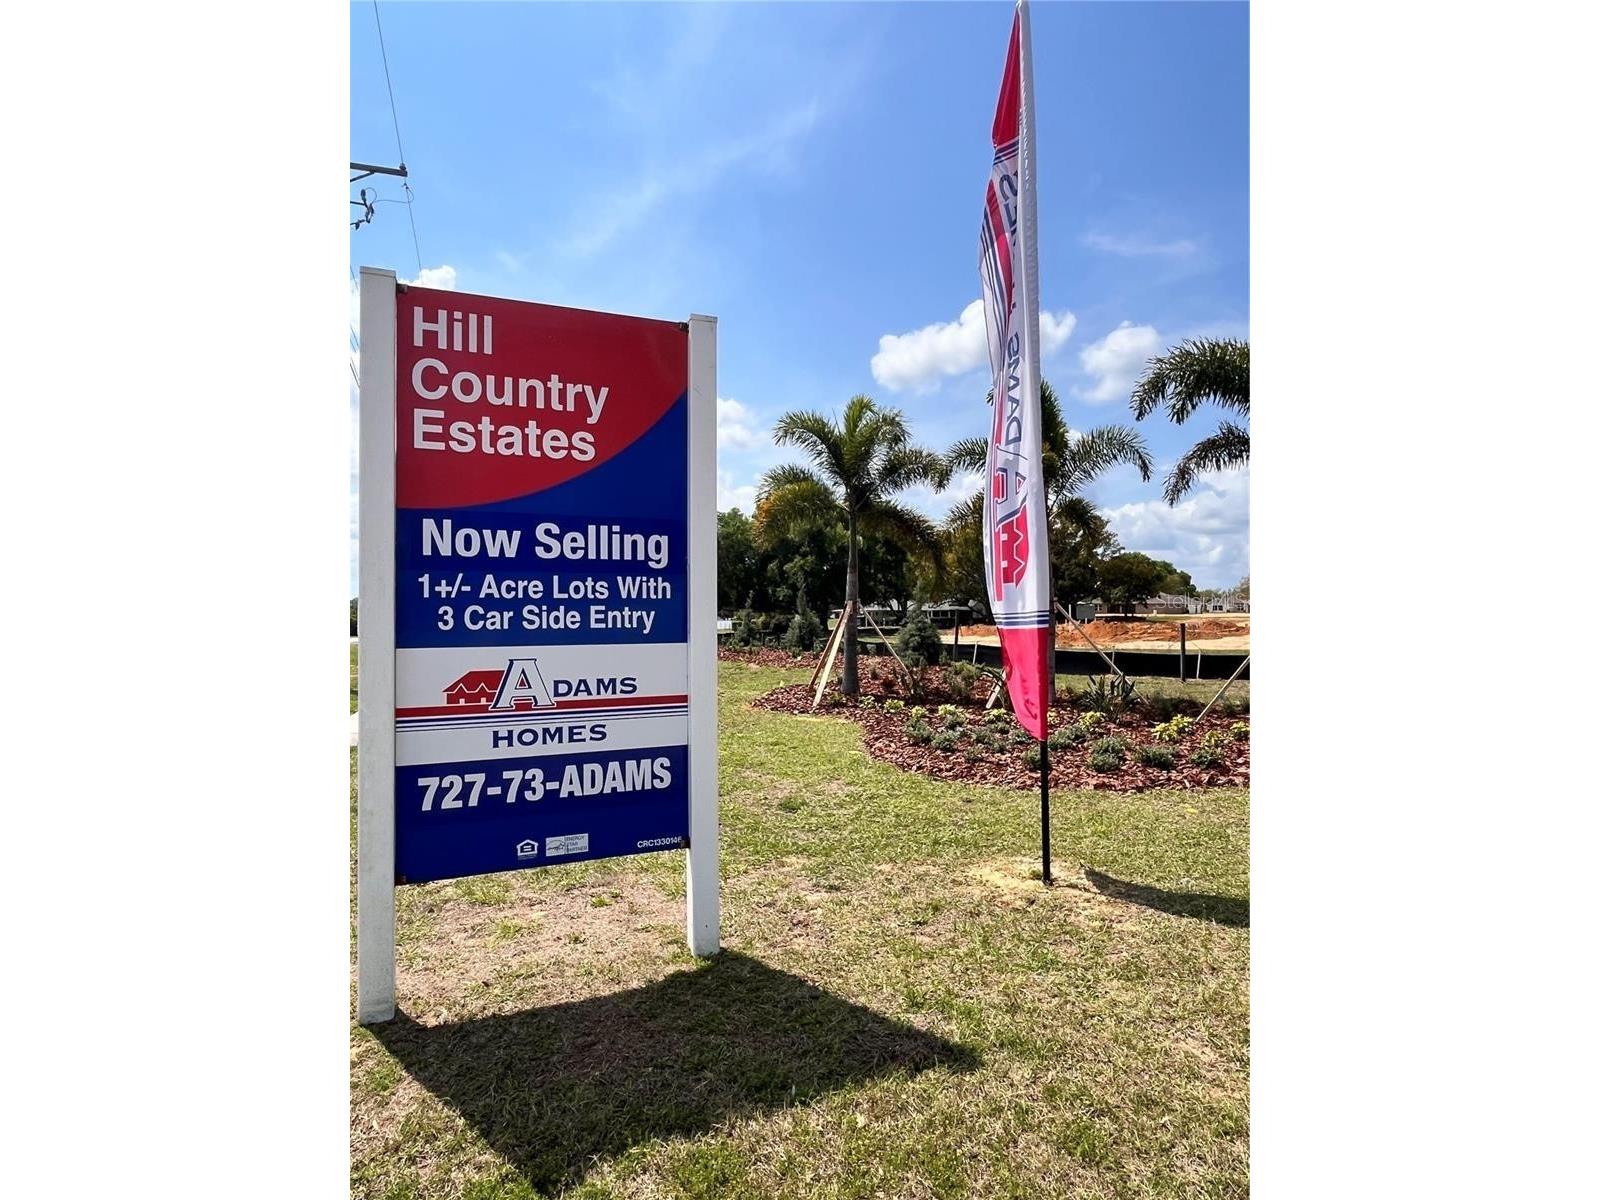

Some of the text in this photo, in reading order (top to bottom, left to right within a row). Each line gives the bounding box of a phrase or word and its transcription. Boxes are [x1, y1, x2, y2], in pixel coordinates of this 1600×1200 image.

[413, 306, 493, 355] Hill
[411, 357, 609, 425] Country
[413, 408, 596, 462] Estates
[422, 518, 669, 569] Now Selling
[418, 573, 672, 600] 1+/- Acre Lots With
[437, 605, 655, 634] 3 Car Side Entry
[489, 658, 638, 711] ADAMS
[492, 724, 608, 749] HOMES
[417, 757, 672, 812] 727-73-ADAMS
